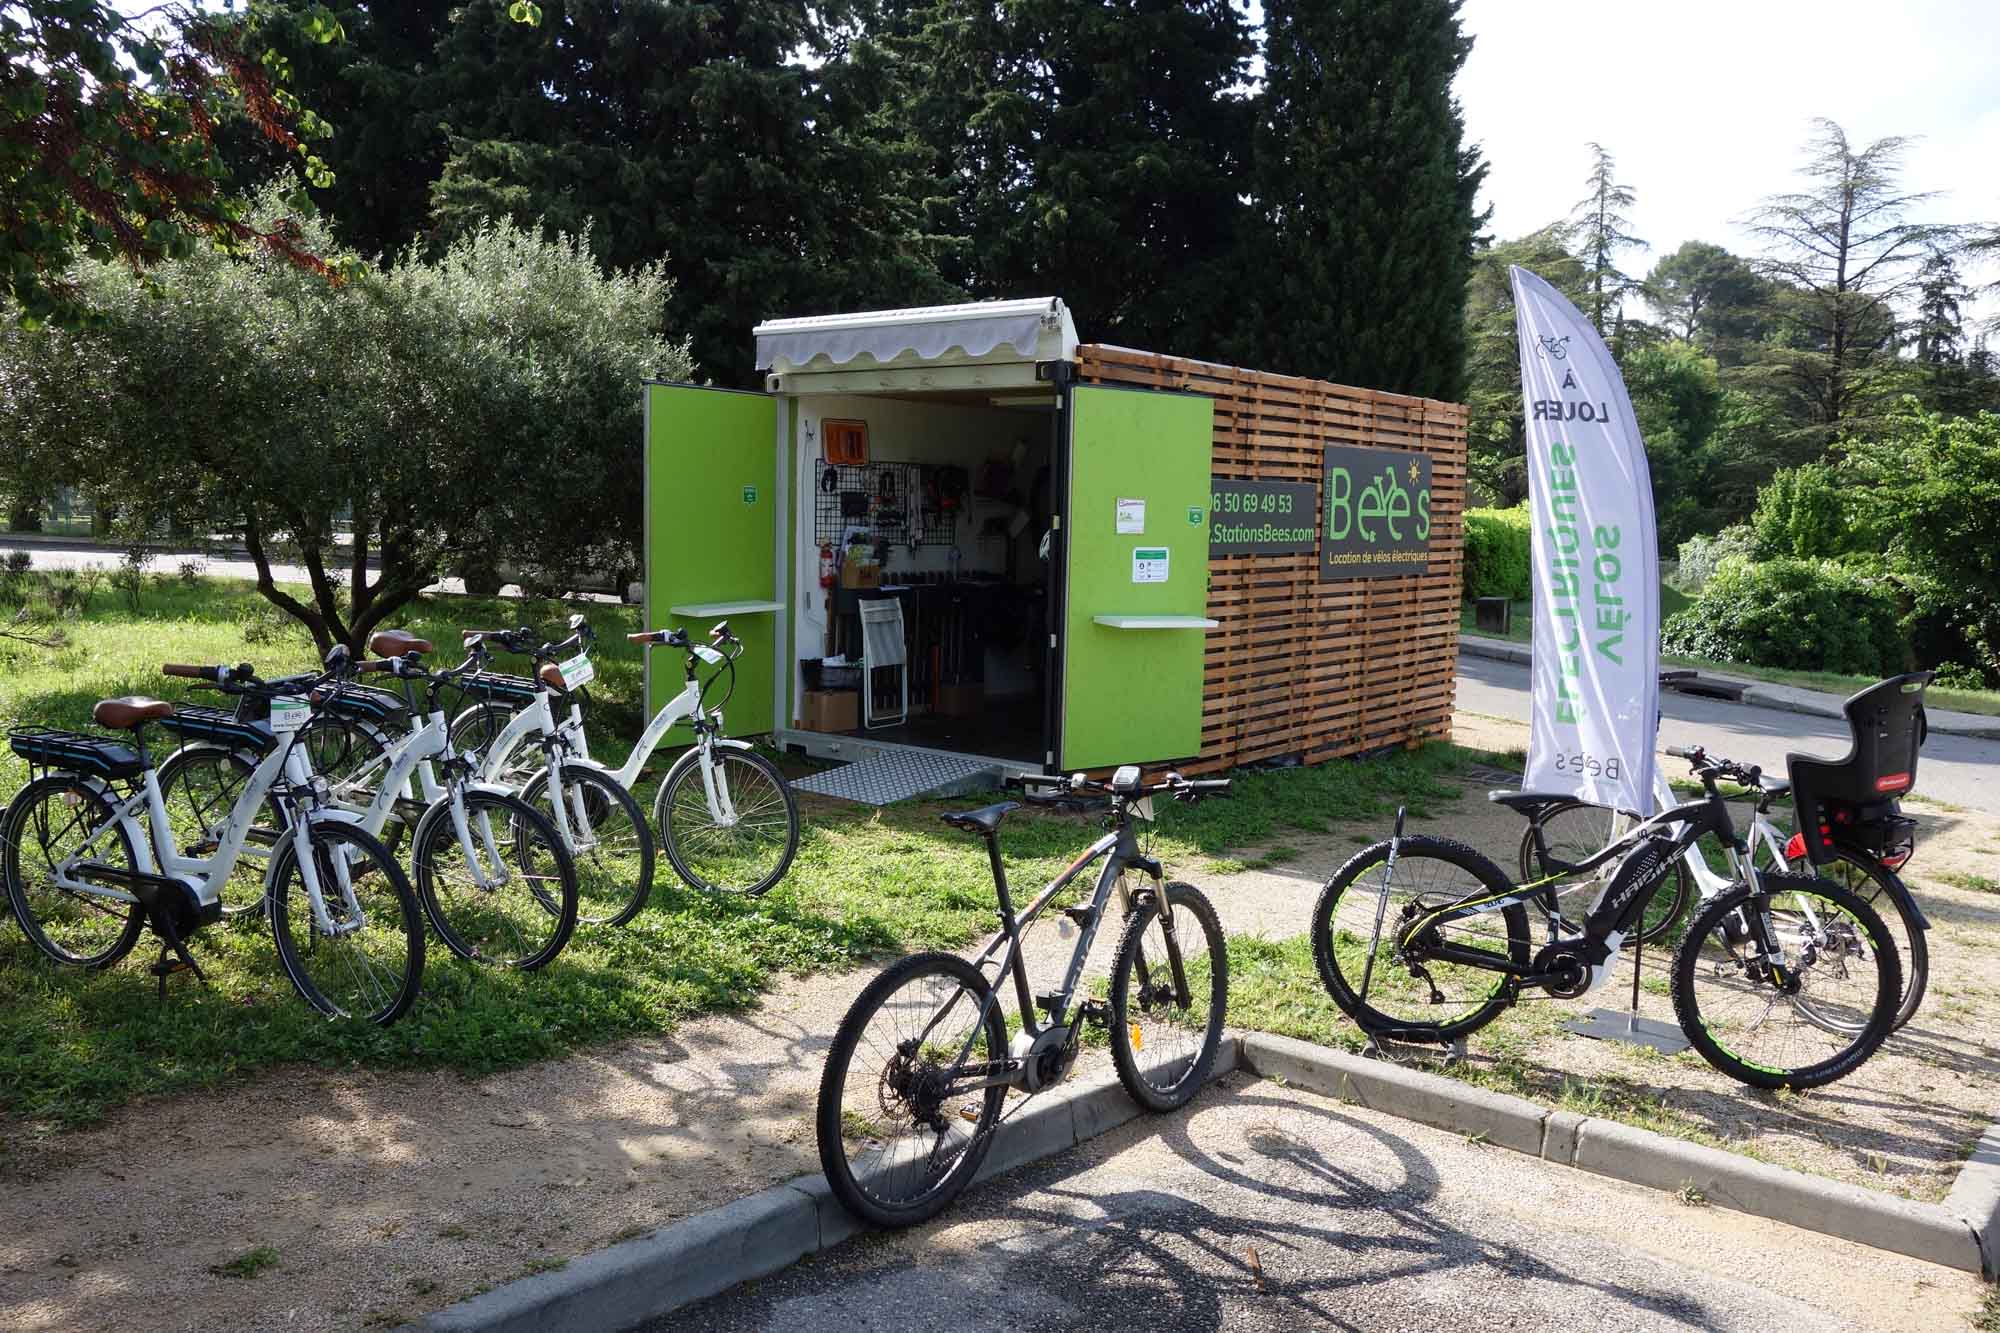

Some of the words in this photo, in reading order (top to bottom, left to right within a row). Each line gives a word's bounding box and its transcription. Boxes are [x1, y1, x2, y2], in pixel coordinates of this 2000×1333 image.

[1225, 493, 1240, 513] 50
[1243, 494, 1258, 513] 69
[1261, 494, 1276, 513] 49
[1278, 494, 1292, 513] 53
[1330, 466, 1431, 543] Bees
[1329, 551, 1361, 565] Location
[1362, 551, 1372, 564] de
[1373, 549, 1391, 563] vélos
[1391, 548, 1428, 565] électriques
